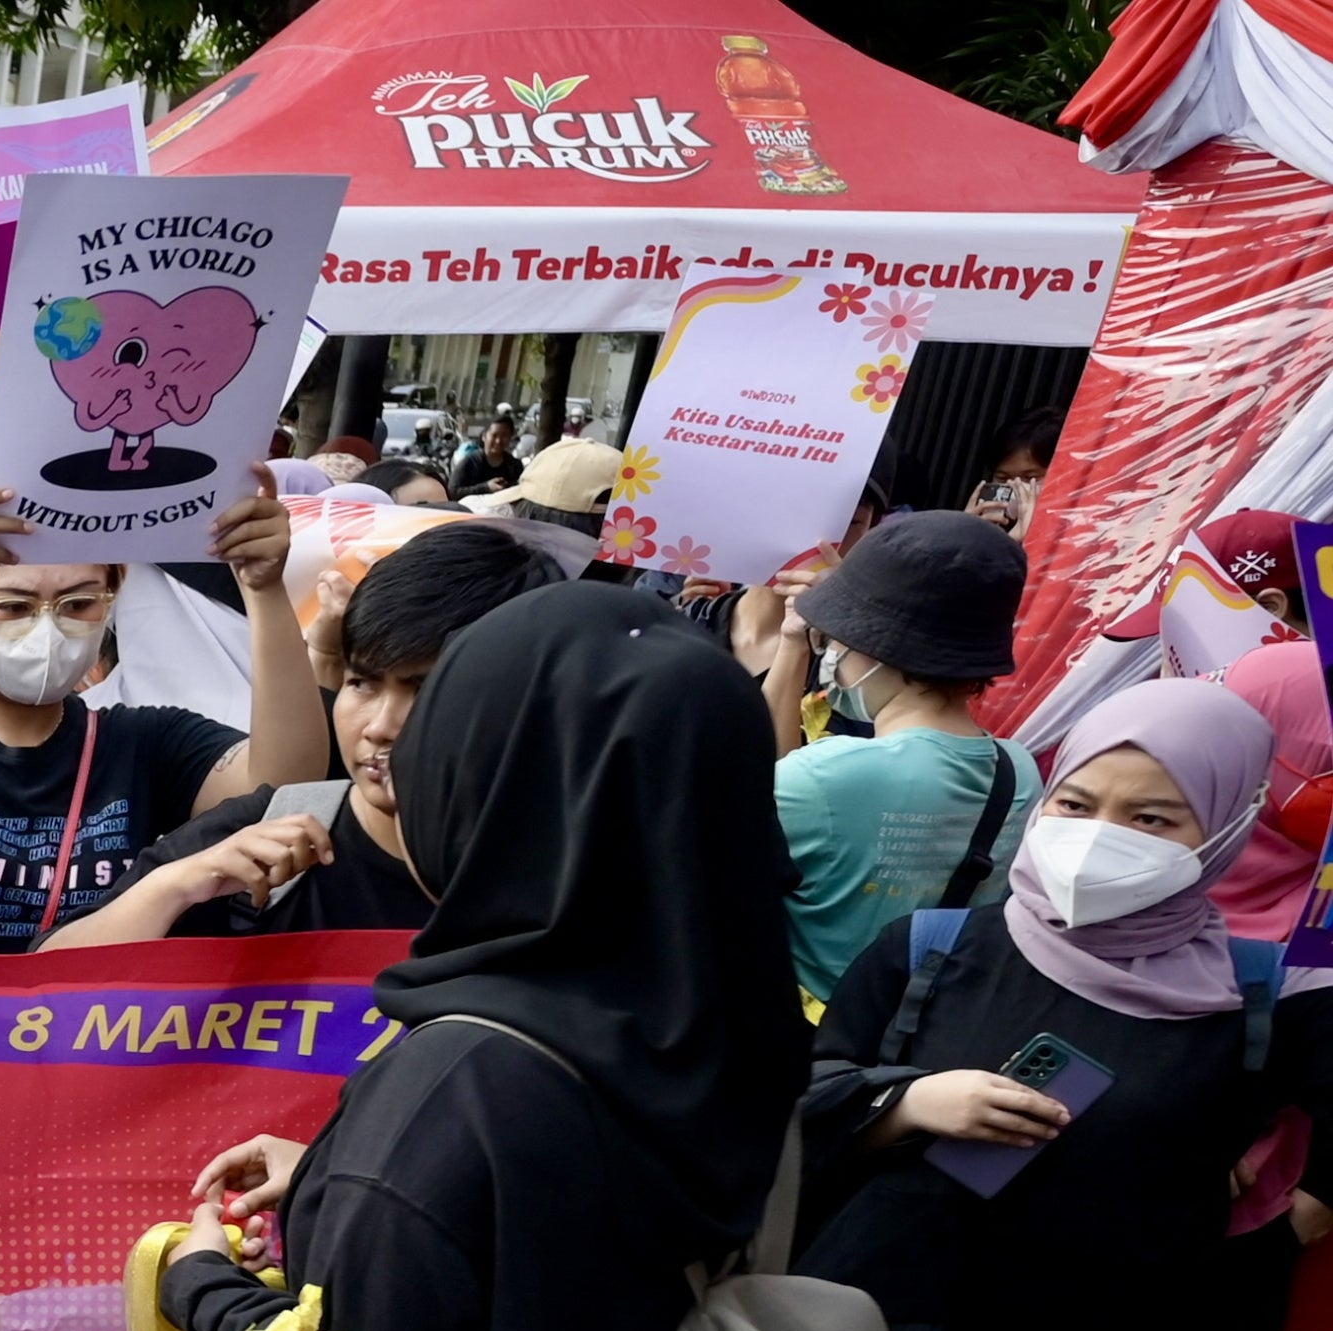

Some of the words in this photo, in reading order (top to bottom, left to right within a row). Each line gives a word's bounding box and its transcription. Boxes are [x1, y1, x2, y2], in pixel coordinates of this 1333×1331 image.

[370, 69, 453, 102] MINUMAN
[374, 74, 496, 116] Teh
[78, 222, 129, 255] MY
[134, 215, 274, 250] CHICAGO
[81, 258, 112, 285] IS
[118, 253, 140, 276] A
[148, 248, 257, 280] WORLD
[422, 246, 501, 282] Teh
[511, 244, 684, 282] Terbaik
[662, 425, 799, 459] Kesetaraan
[801, 445, 839, 464] Itu
[669, 406, 720, 427] Kita
[723, 413, 845, 444] Usahakan
[15, 496, 139, 534] WITHOUT
[142, 490, 217, 529] SGBV
[7, 1004, 54, 1053] 8
[72, 999, 334, 1057] MARET
